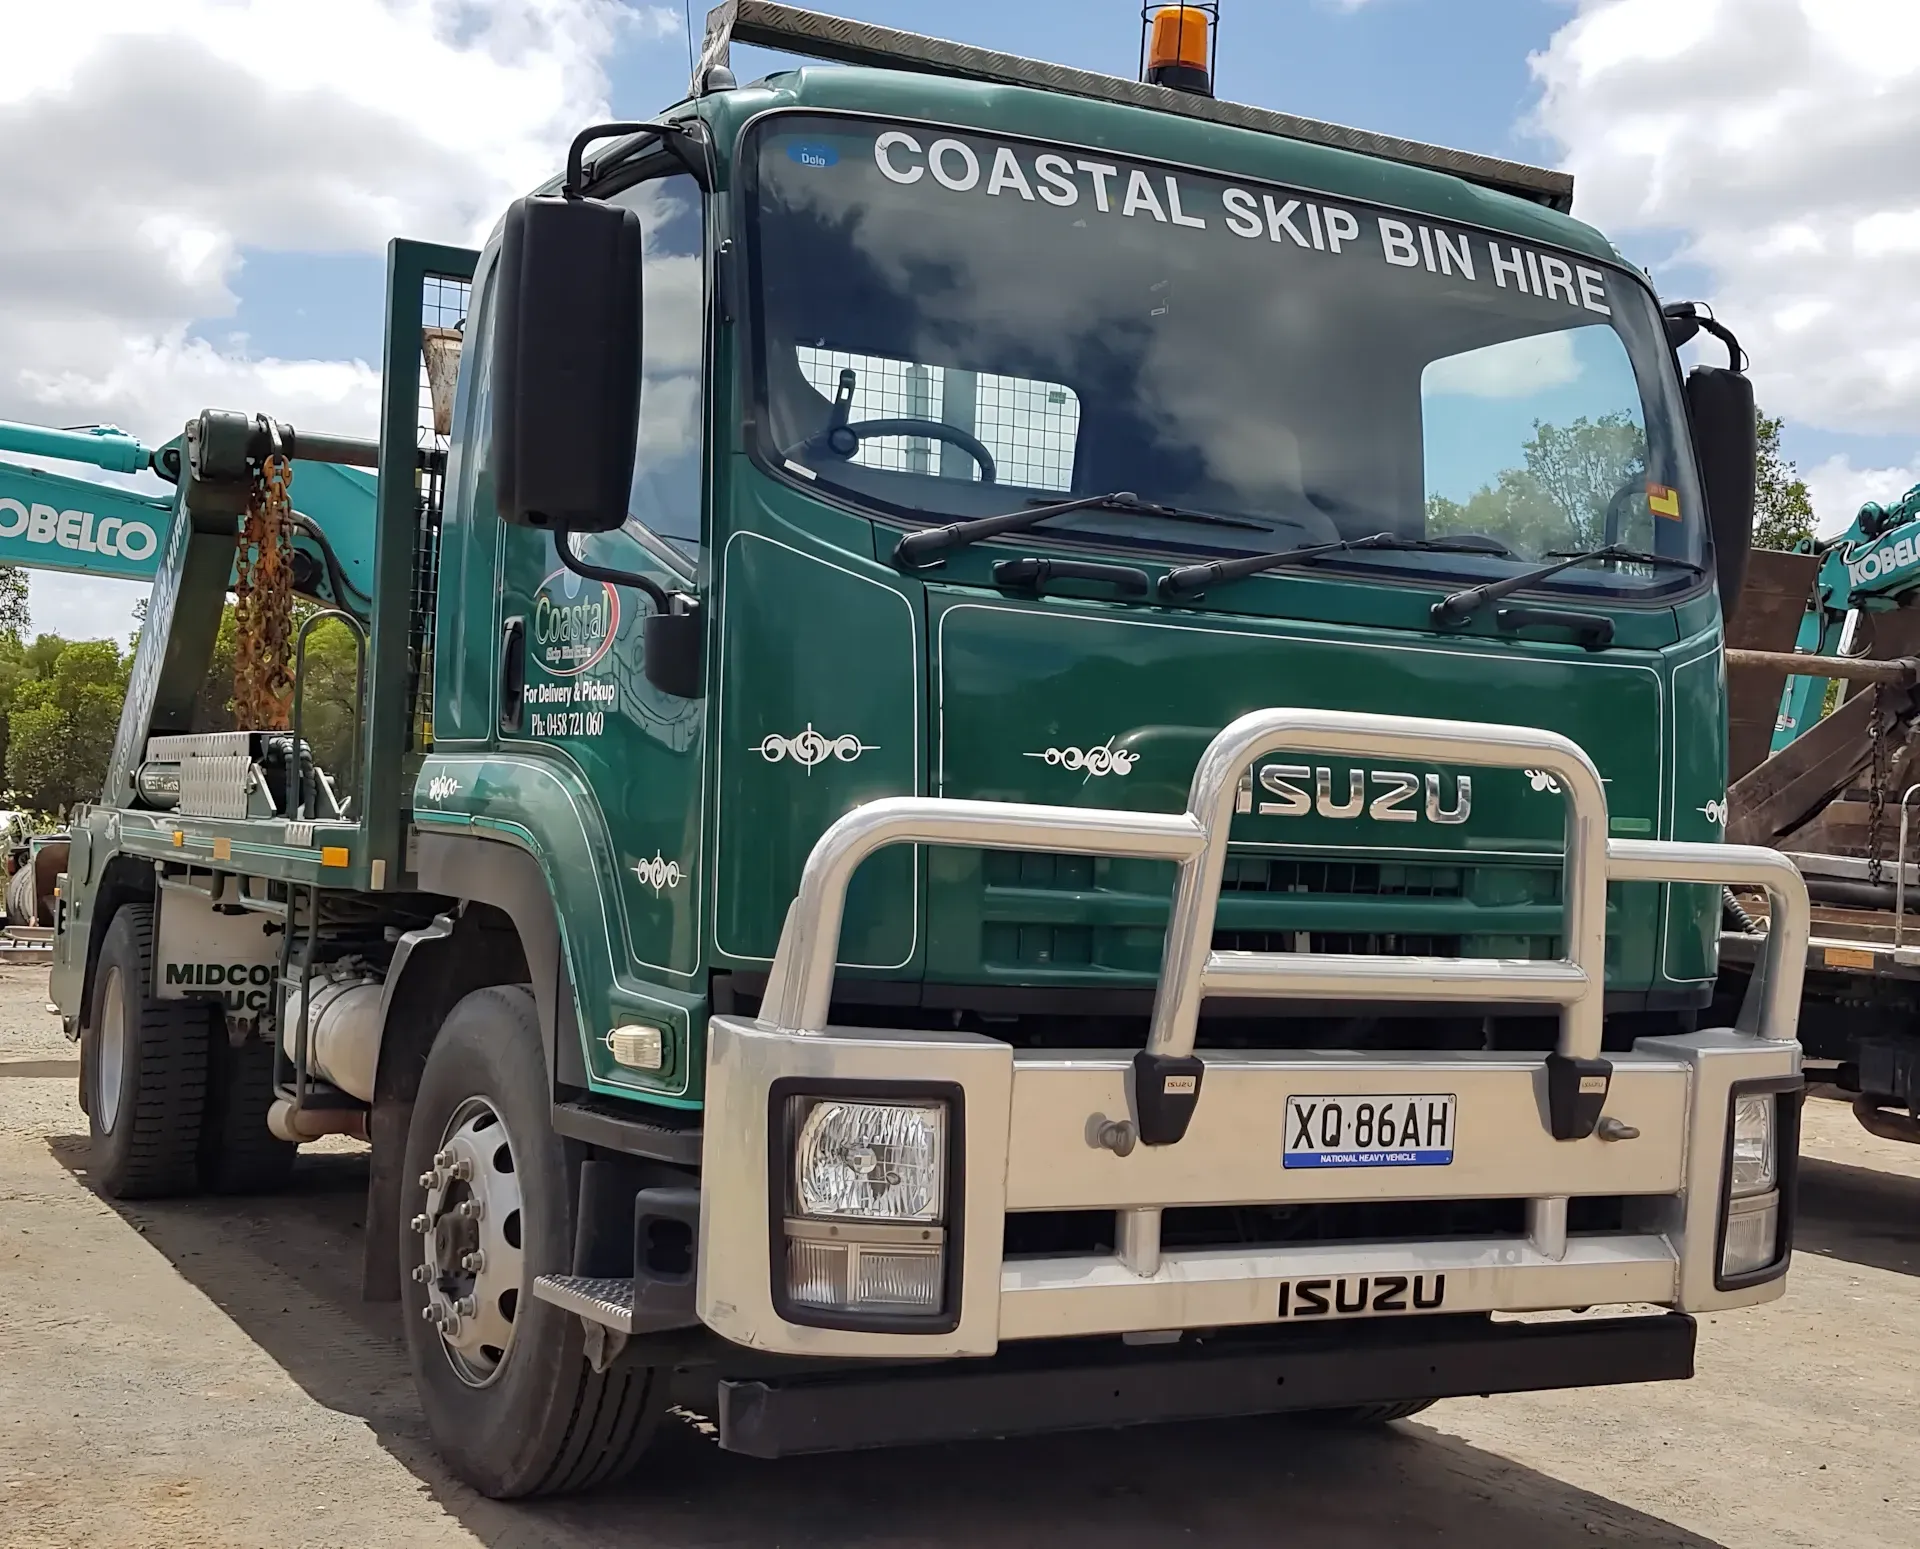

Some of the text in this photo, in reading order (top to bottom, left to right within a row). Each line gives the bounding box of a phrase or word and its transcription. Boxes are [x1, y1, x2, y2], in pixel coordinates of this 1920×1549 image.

[873, 131, 1612, 316] COASTAL SKIP BIN HIRE
[166, 491, 189, 580] HIRE
[1848, 533, 1920, 587] KOBEL
[535, 590, 610, 645] Coastal
[523, 680, 615, 707] For Delivery & Pickup
[531, 711, 604, 736] Ph: 0458 721 060
[1235, 763, 1472, 824] ISUZU
[1320, 1153, 1416, 1163] NATIONAL HEAVY VEHICLE
[1278, 1274, 1445, 1317] ISUZU
